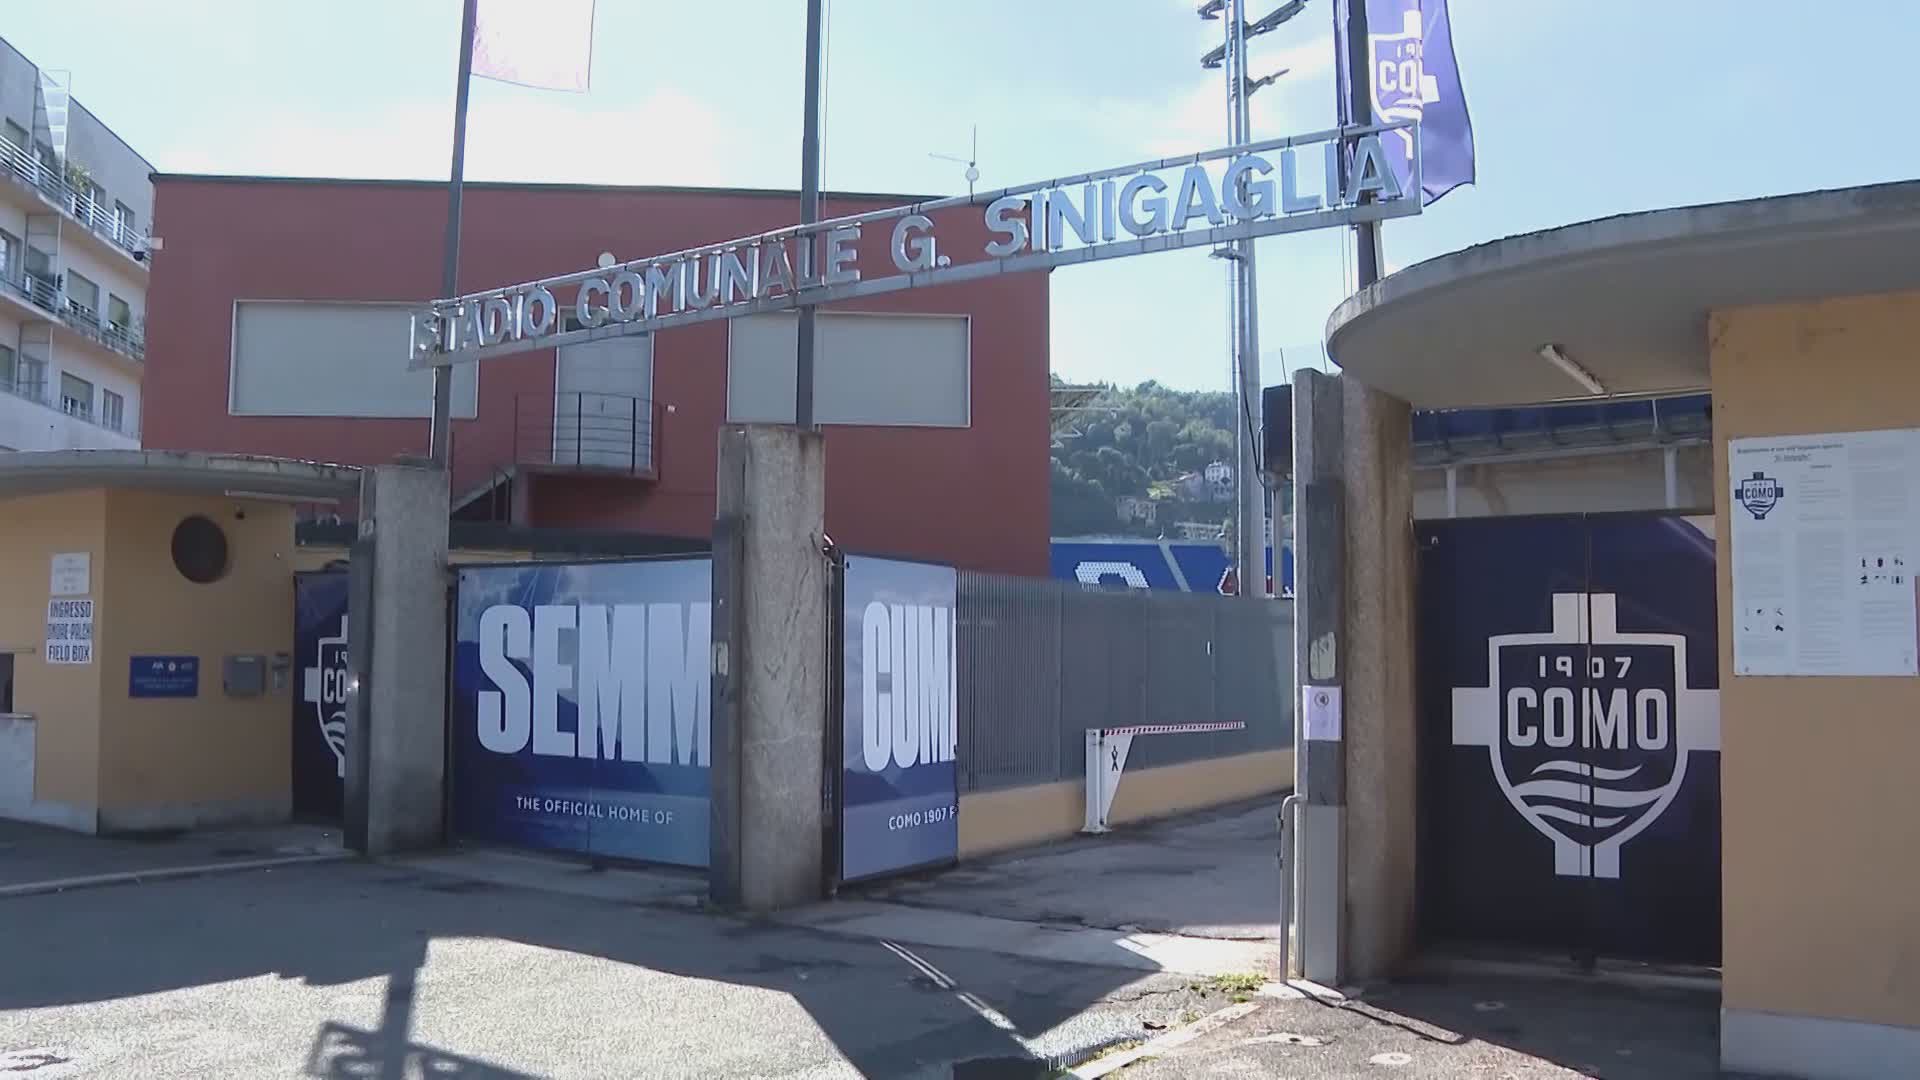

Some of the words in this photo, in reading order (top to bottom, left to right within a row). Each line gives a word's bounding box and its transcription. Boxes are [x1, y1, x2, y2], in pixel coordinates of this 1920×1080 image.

[416, 287, 556, 351] STADIO
[576, 225, 861, 328] COMUNALE
[891, 216, 951, 272] G.
[985, 137, 1402, 256] SINIGAGLIA
[1744, 487, 1774, 499] COMO
[50, 601, 92, 618] INGRESSO
[72, 645, 90, 661] BOX
[1539, 656, 1632, 679] 1907
[477, 604, 712, 768] SEMM
[862, 601, 957, 772] CUM
[1507, 687, 1669, 750] COMO
[516, 796, 540, 811] THE
[545, 799, 603, 818] OFFICIAL
[609, 805, 649, 822] HOME
[655, 810, 673, 824] OF
[888, 811, 920, 830] COMO
